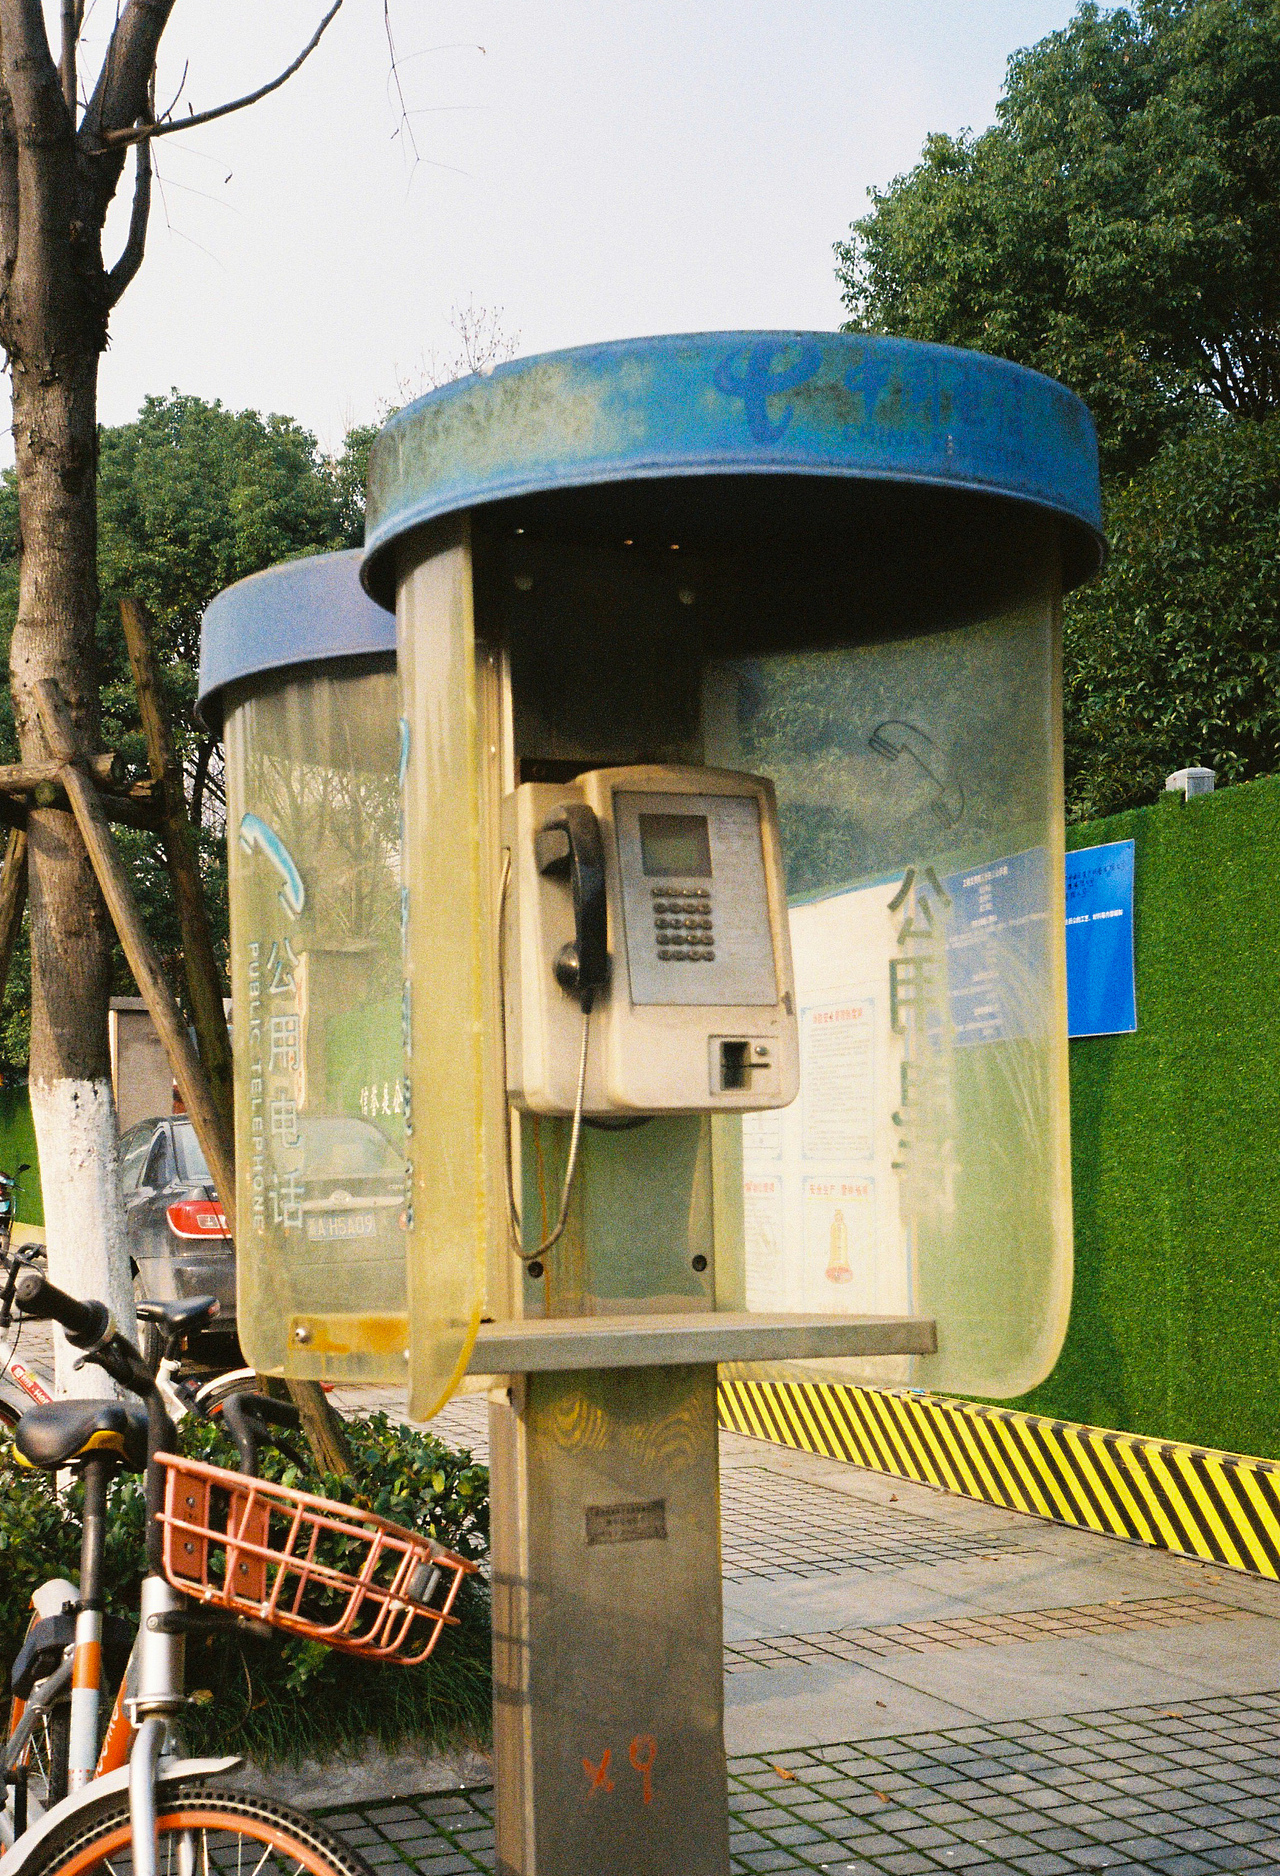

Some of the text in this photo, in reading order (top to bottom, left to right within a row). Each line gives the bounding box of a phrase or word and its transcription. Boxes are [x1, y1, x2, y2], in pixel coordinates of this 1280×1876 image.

[247, 942, 265, 1230] PUBLIC TELEPHONE
[266, 937, 305, 1228] 公用电话
